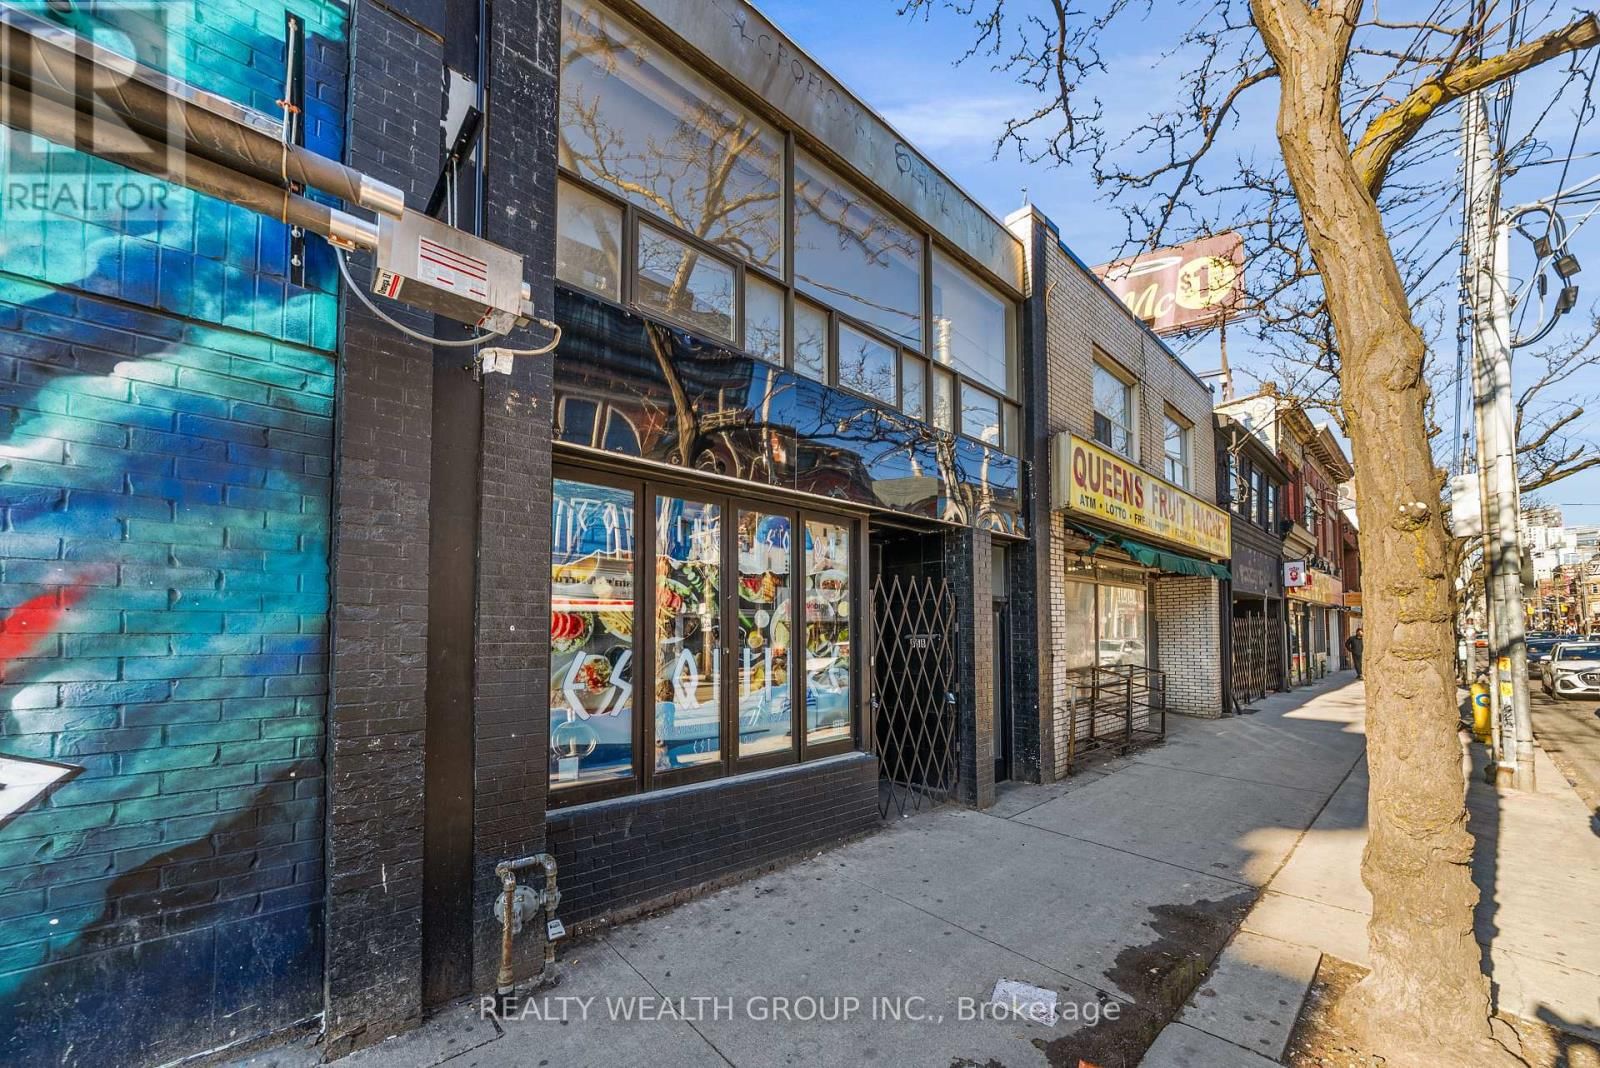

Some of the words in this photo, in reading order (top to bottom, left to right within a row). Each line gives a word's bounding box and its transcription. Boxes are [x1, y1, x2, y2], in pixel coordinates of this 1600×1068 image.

[1073, 446, 1145, 509] QUEENS
[1151, 484, 1186, 526] FRUIT
[1079, 494, 1097, 510] ATM
[1105, 502, 1127, 520] LOTTO
